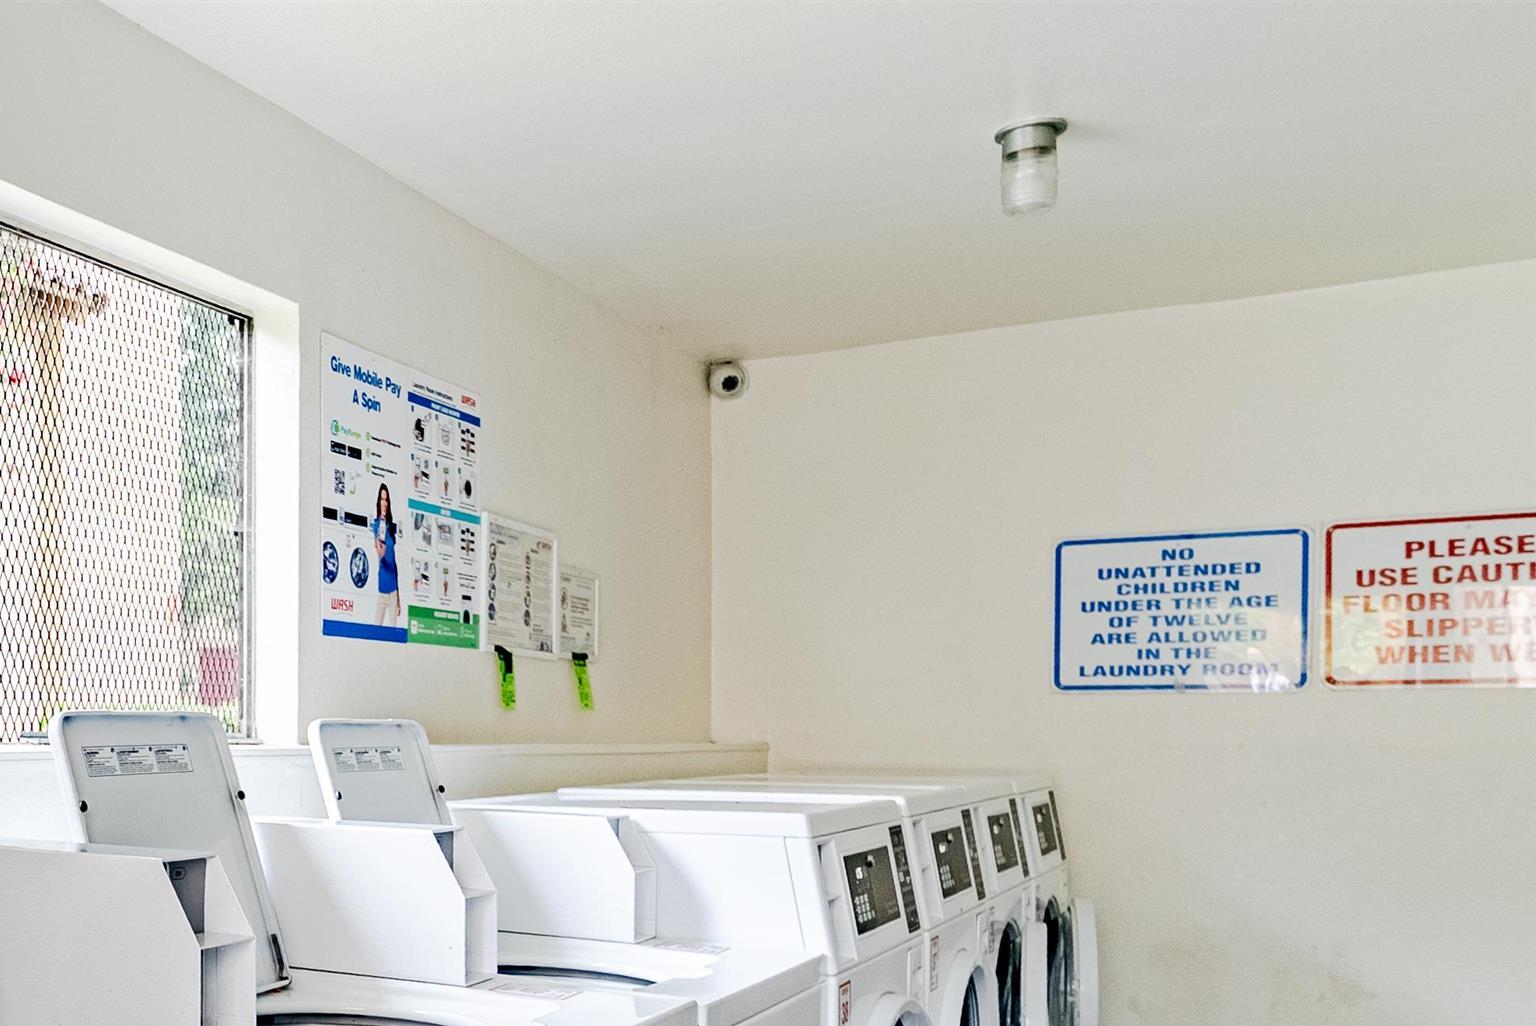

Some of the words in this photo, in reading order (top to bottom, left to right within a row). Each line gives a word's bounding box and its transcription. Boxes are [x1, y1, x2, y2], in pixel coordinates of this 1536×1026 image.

[330, 355, 351, 377] Give
[354, 364, 382, 388] Mobile
[386, 376, 401, 398] Pay
[353, 389, 359, 405] A
[362, 392, 381, 412] Spin
[1162, 548, 1194, 561] NO
[1405, 535, 1536, 559] PLEASE
[1098, 562, 1261, 580] UNATTENDED
[1356, 567, 1418, 587] USE
[1116, 580, 1240, 596] CHILDREN
[331, 598, 354, 612] WASH
[1081, 600, 1161, 613] UNDER
[1171, 598, 1218, 610] THE
[1229, 595, 1279, 608] AGE
[1343, 592, 1450, 615] FLOOR
[1109, 616, 1138, 628] OF
[1149, 613, 1248, 628] TWELVE
[1091, 632, 1137, 644] ARE
[1148, 629, 1266, 644] ALLOWED
[1137, 649, 1160, 660] IN
[1171, 647, 1216, 660] THE
[1375, 646, 1474, 665] WHEN
[1079, 665, 1191, 677] LAUNDRY
[1202, 663, 1279, 676] ROOM
